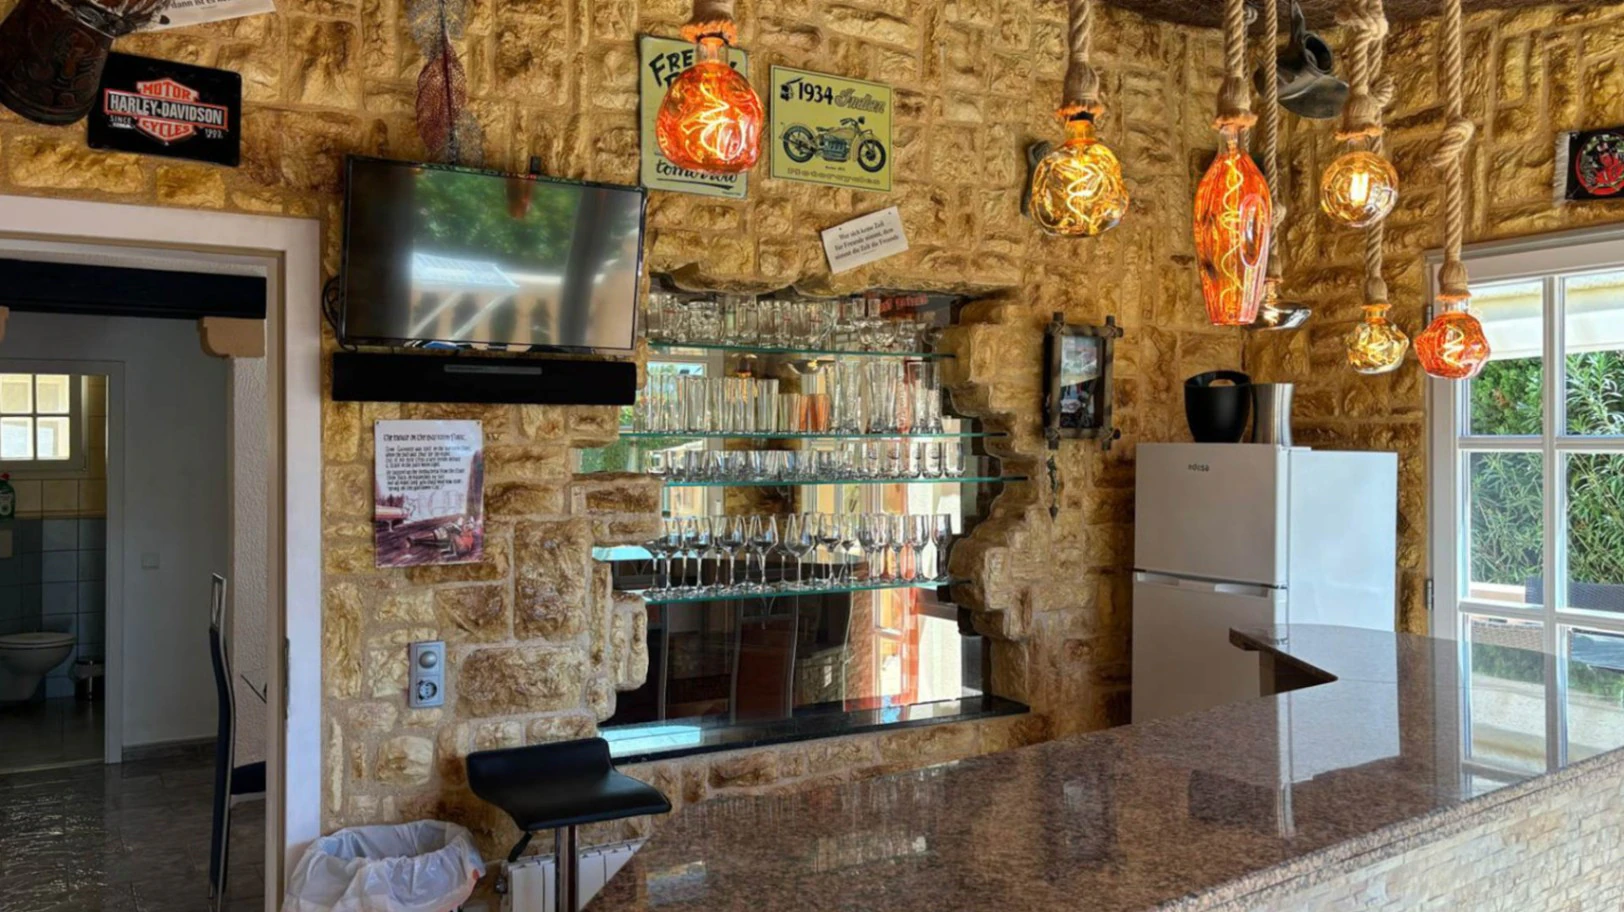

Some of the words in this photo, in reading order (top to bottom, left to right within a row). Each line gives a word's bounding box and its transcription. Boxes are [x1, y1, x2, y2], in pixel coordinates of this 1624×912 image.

[649, 49, 694, 87] FRE
[142, 81, 192, 100] MOTOR
[798, 82, 833, 105] 1934
[110, 94, 222, 125] HARLEY-DAVIDSON
[110, 115, 132, 125] SINCE
[142, 119, 191, 138] CYCLES
